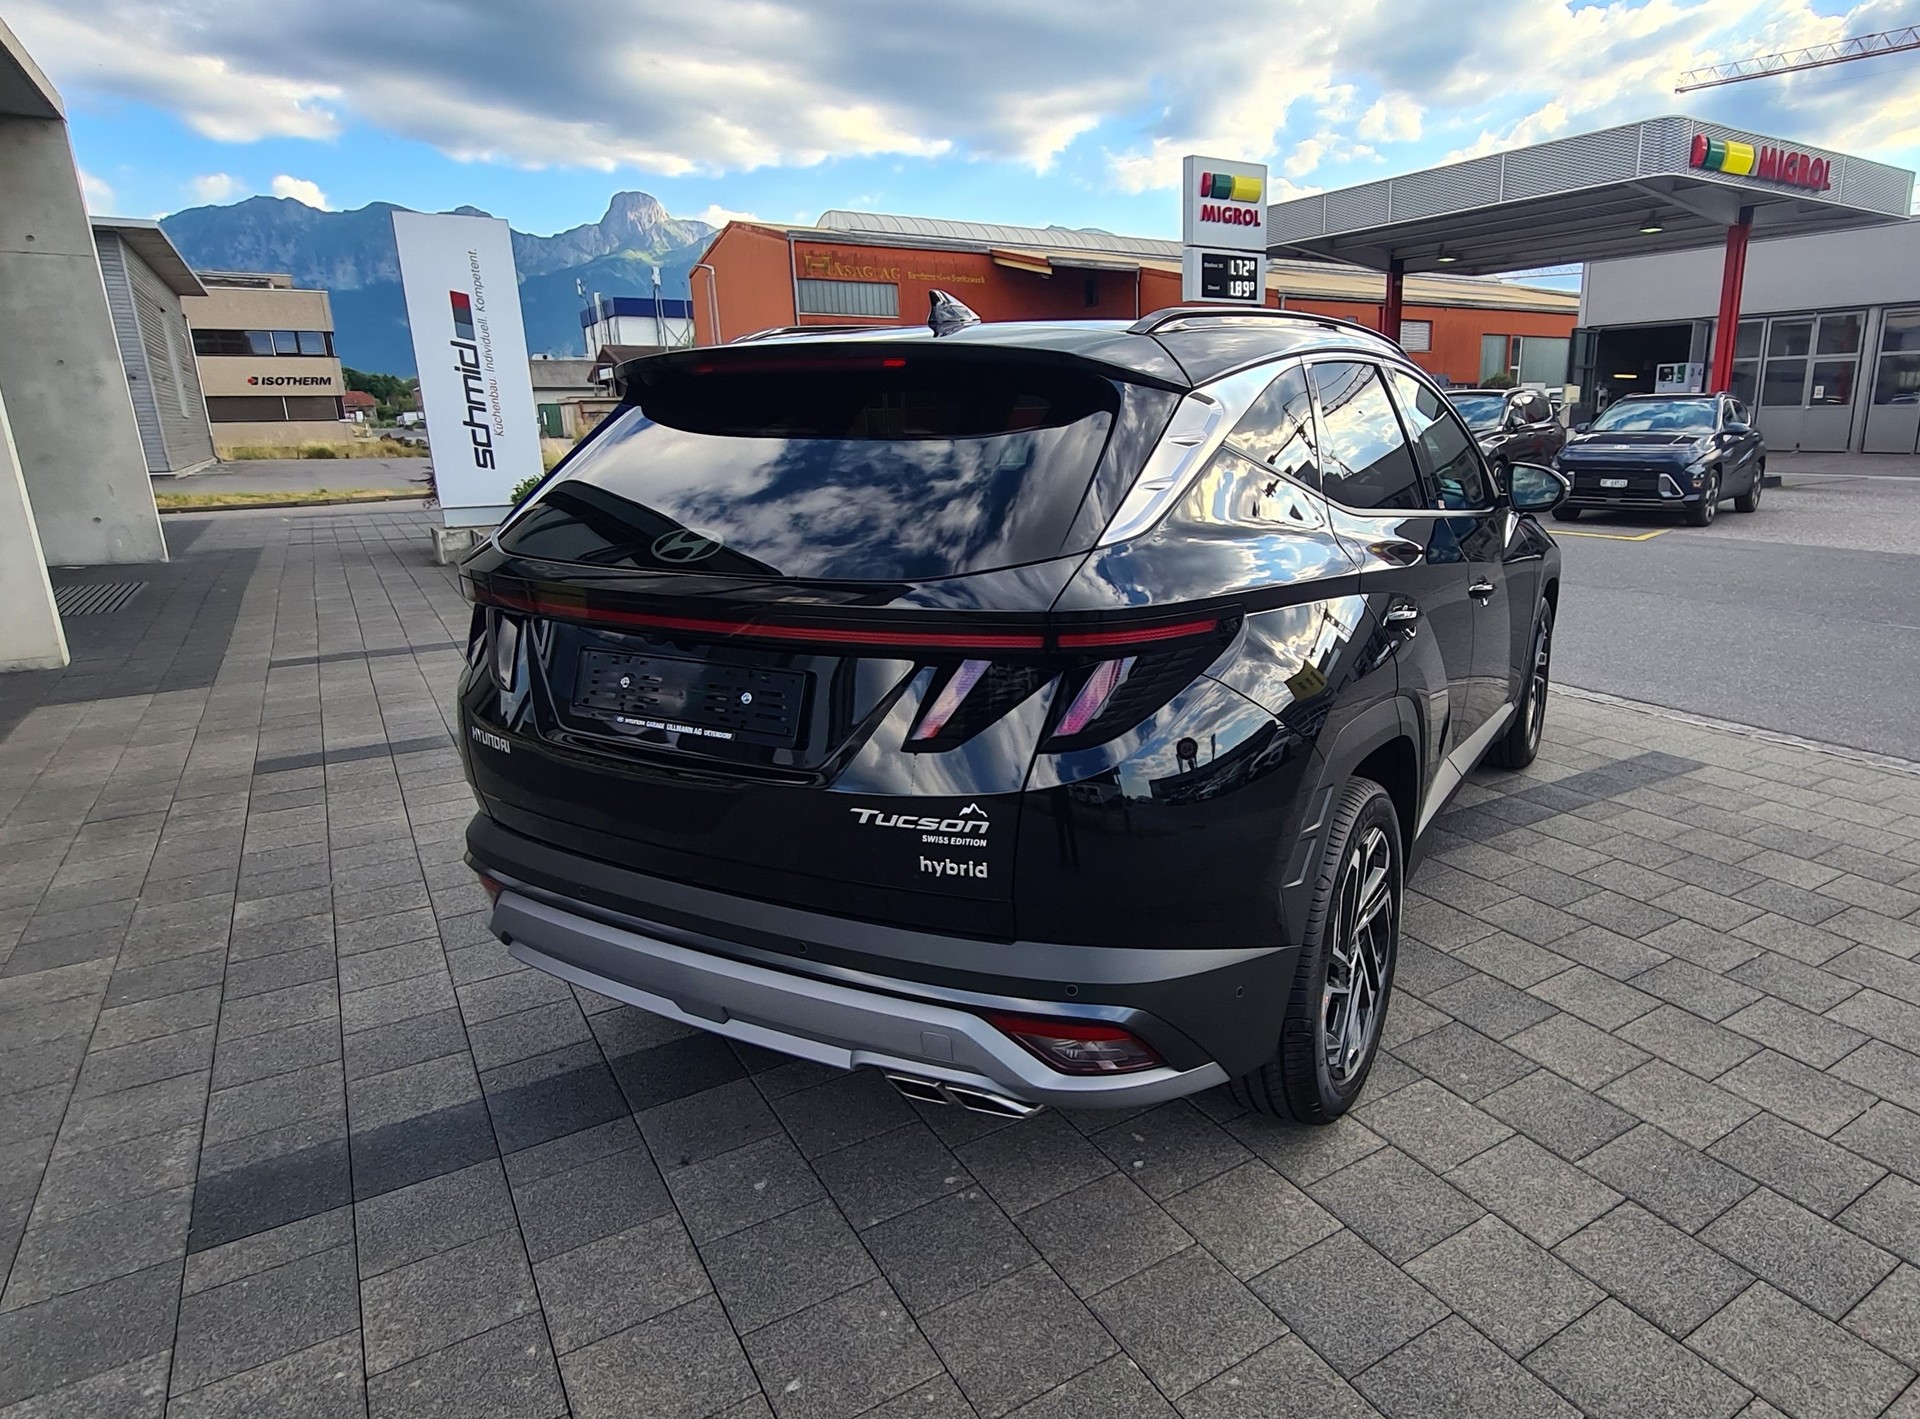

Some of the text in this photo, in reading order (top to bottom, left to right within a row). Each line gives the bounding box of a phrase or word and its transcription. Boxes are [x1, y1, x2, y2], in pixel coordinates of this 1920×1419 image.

[1756, 146, 1831, 191] MIGROL
[1200, 204, 1261, 227] MIGROL
[804, 255, 873, 278] HASAG
[881, 267, 900, 279] AG
[468, 248, 505, 437] Küchenbau. Individuell. Kompetent.
[261, 376, 332, 386] ISOTHERM
[450, 340, 496, 470] schmid
[646, 720, 665, 730] GARAGE
[666, 724, 693, 734] ULLMANN
[694, 727, 702, 735] AG
[471, 725, 511, 754] HYUNDAI
[921, 834, 988, 847] SWISS EDITION
[919, 856, 988, 878] hybrid
